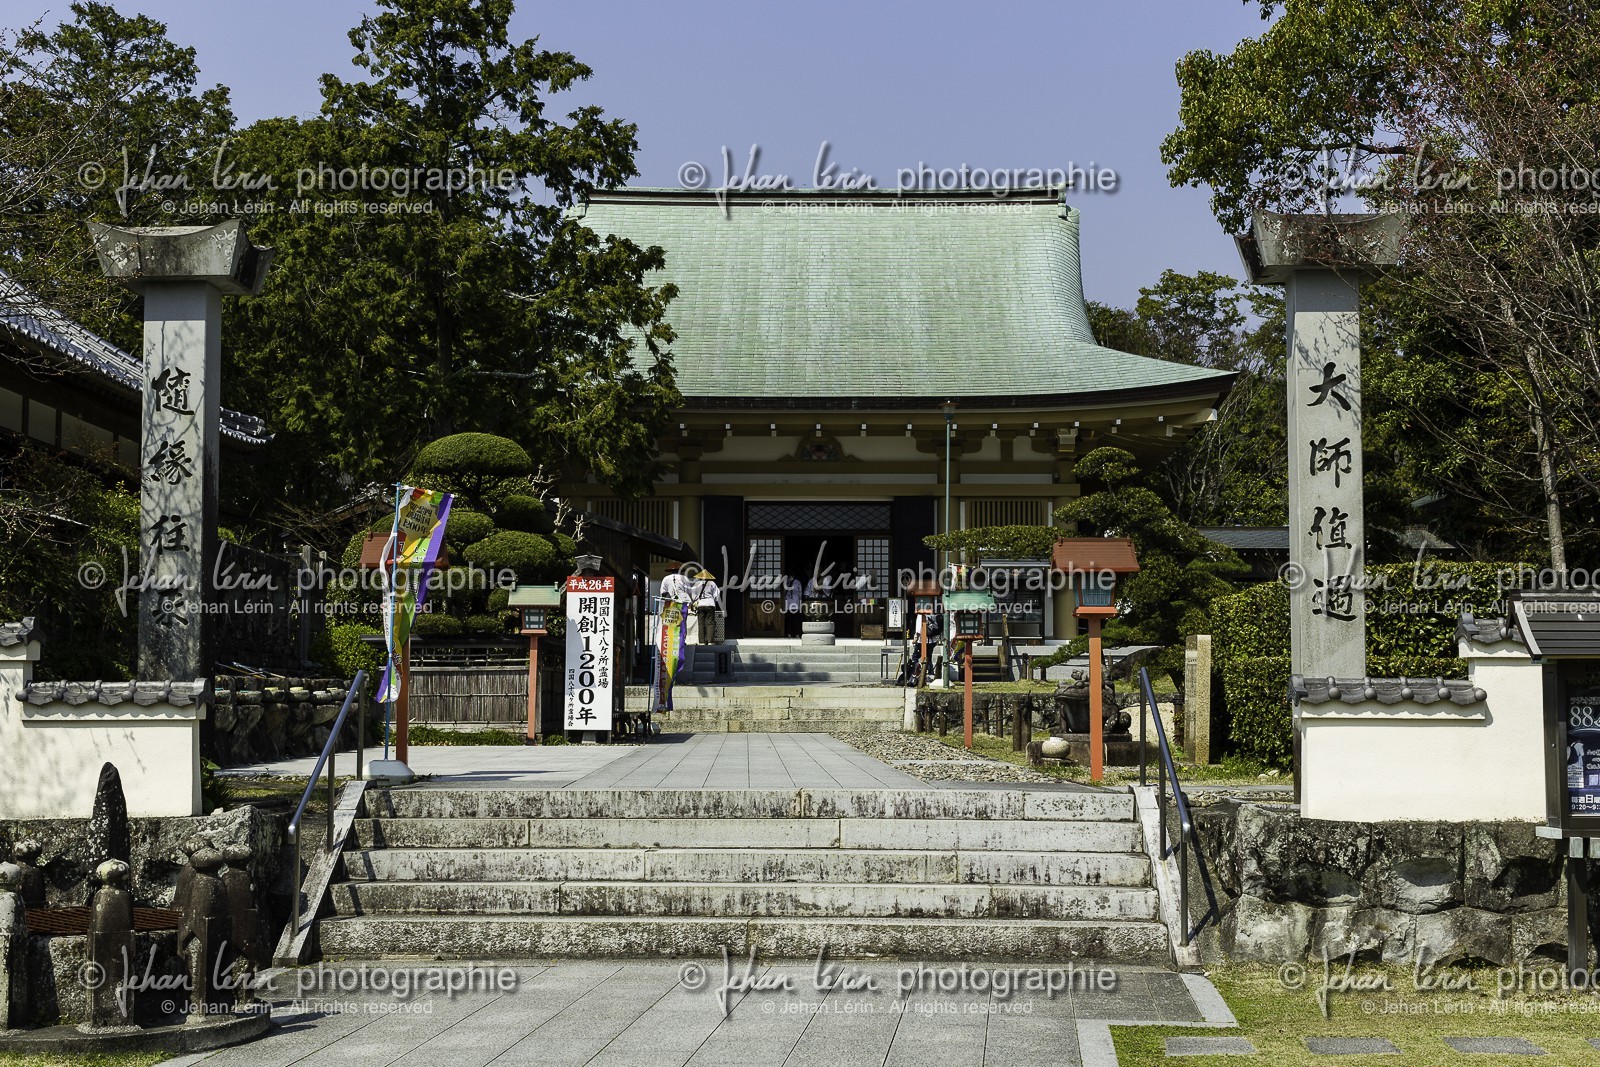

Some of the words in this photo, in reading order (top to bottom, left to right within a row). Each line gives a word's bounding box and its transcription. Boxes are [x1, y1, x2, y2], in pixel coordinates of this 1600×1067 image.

[568, 579, 613, 591] 平成26年
[575, 596, 599, 726] 開創1200年
